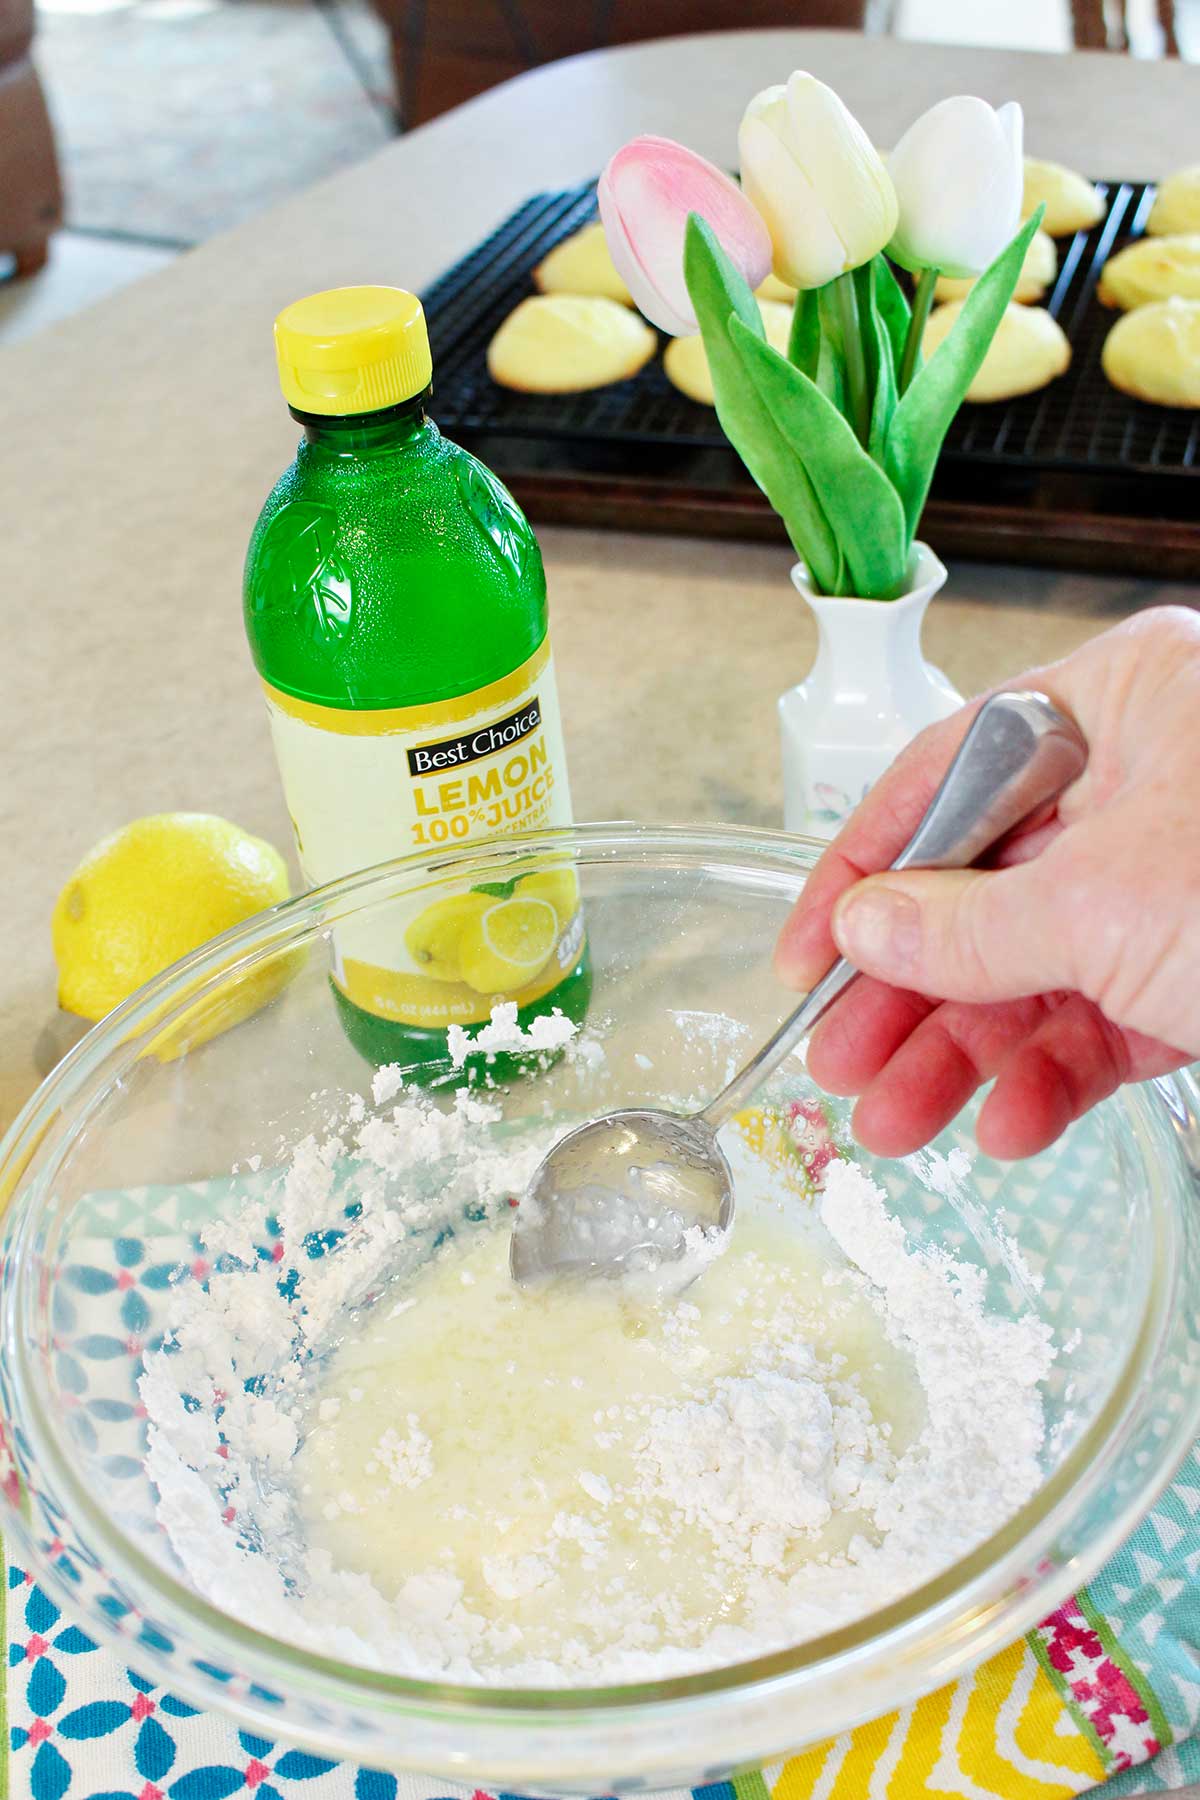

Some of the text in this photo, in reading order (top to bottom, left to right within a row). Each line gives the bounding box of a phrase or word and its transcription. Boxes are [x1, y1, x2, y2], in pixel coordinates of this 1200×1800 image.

[413, 735, 548, 816] LEMON
[414, 709, 538, 772] Best Choice
